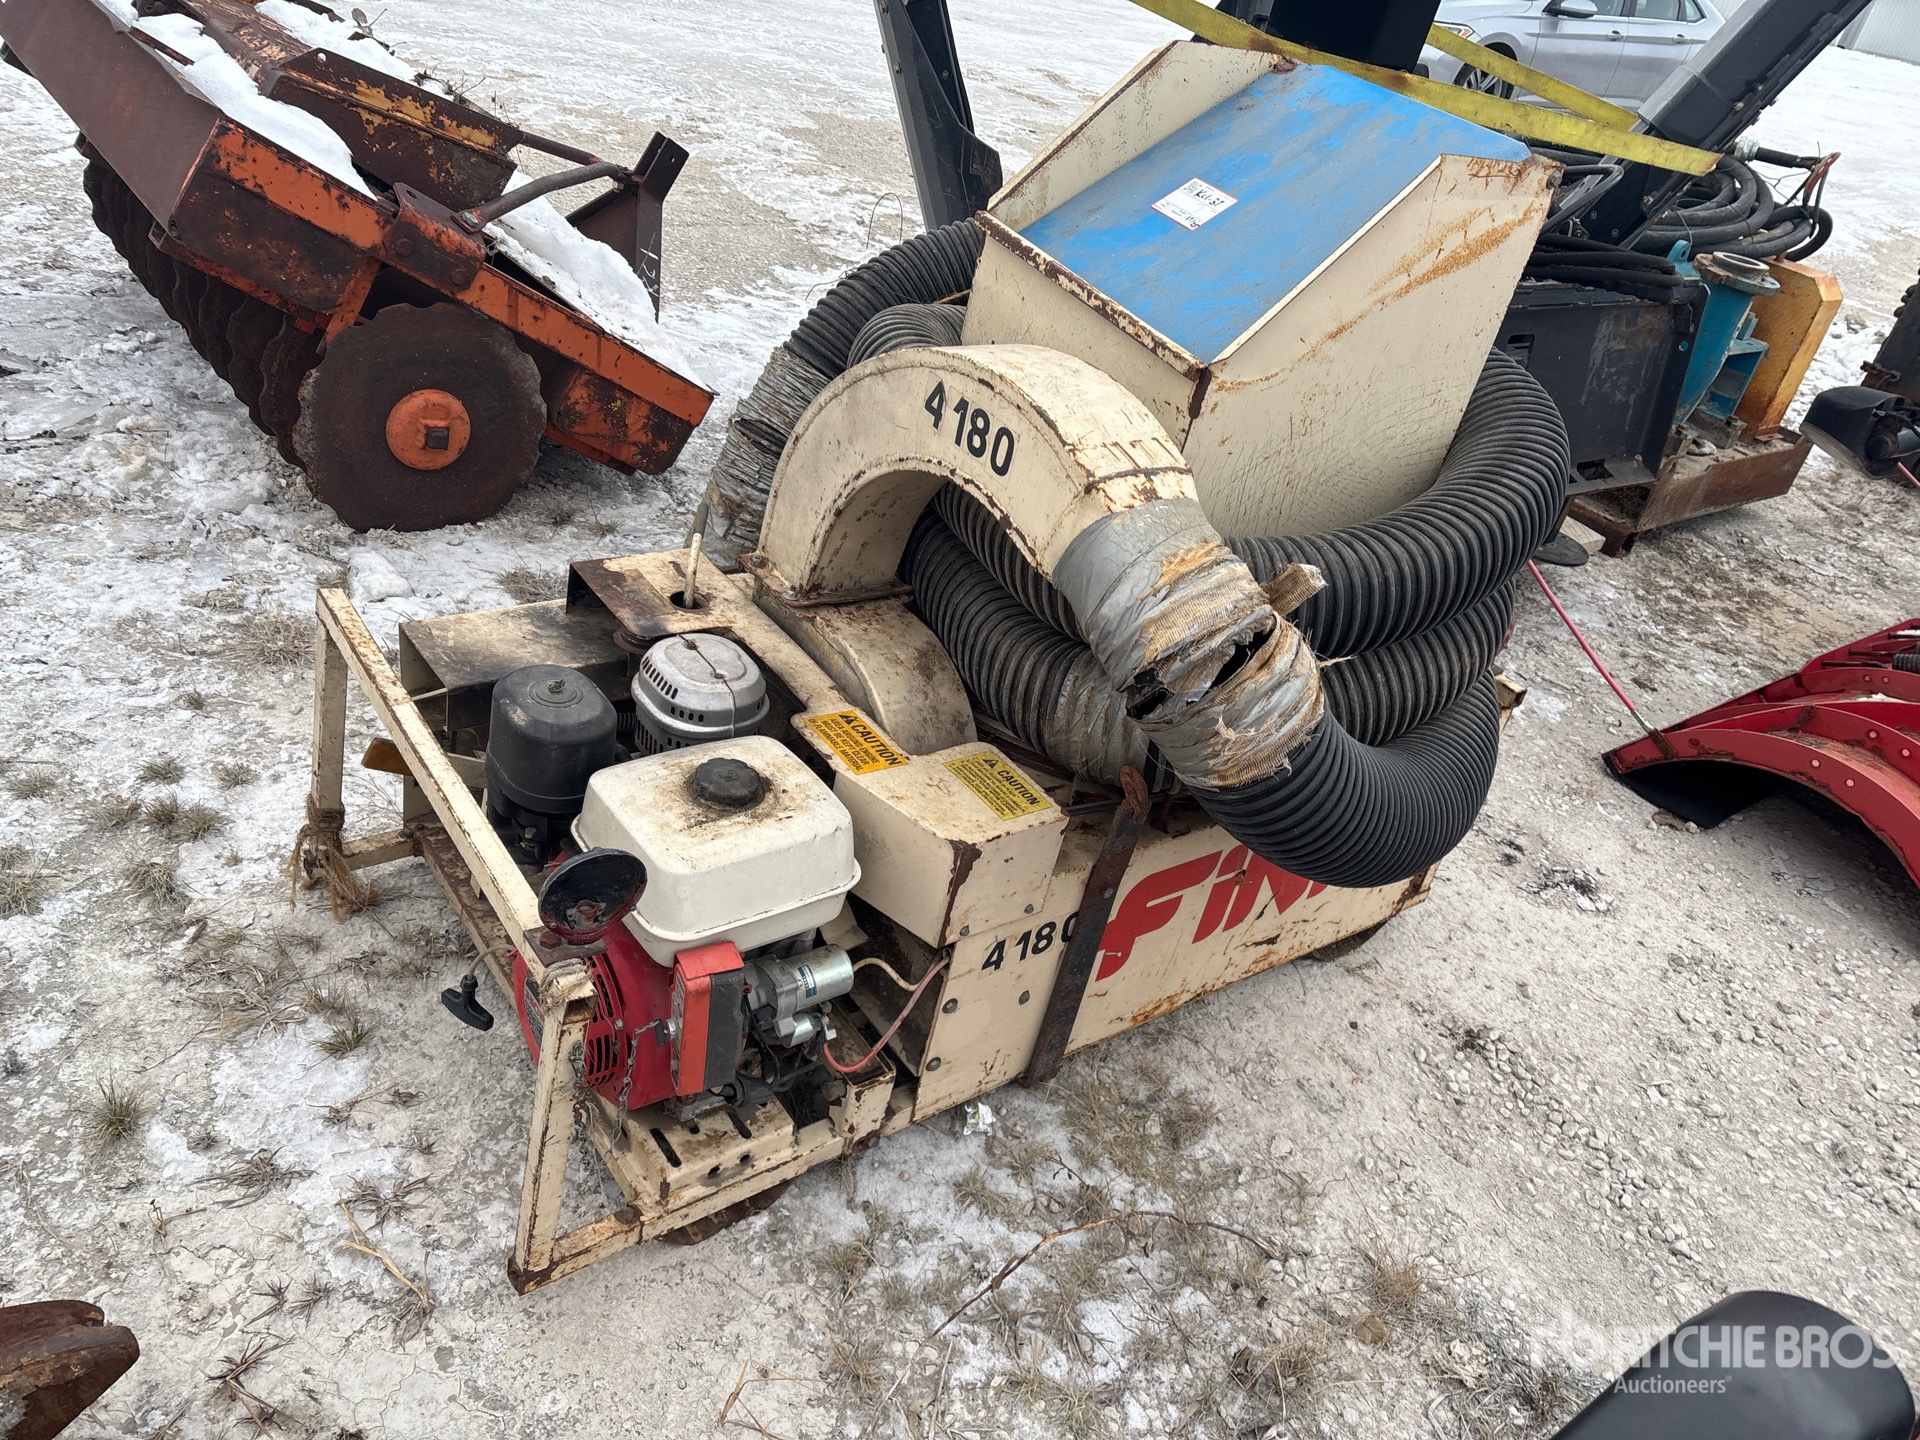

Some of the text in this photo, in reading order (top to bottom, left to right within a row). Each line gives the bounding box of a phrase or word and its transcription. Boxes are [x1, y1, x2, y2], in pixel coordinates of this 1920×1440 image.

[924, 379, 1015, 477] 4180
[807, 718, 865, 772] OF FLAMMABLE MATERIAL
[820, 719, 871, 766] MUST BE KEPT CLEAR
[829, 718, 881, 764] AREA AROUND ENGINE
[850, 723, 903, 766] CAUTION
[996, 769, 1041, 805] CAUTION
